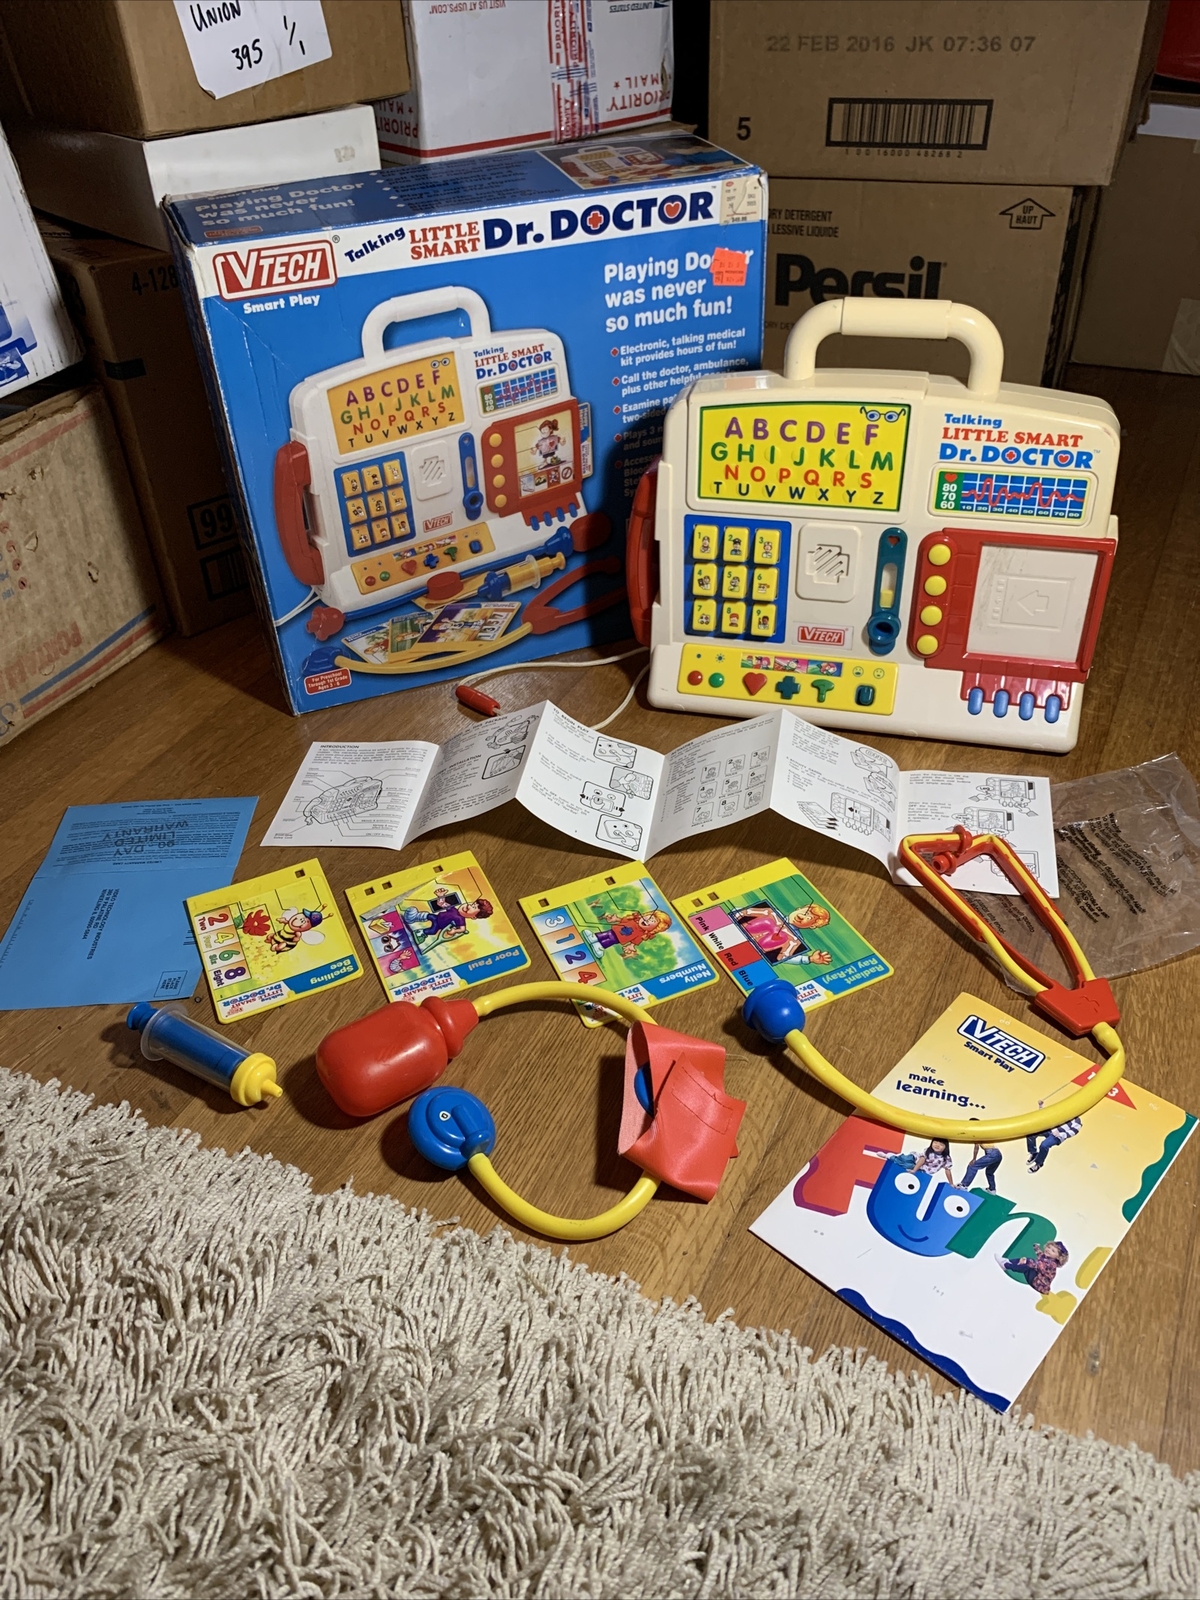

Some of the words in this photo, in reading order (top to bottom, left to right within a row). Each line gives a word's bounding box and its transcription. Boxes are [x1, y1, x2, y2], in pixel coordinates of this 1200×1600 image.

[190, 0, 241, 31] UNION
[609, 4, 629, 14] STATES
[631, 2, 653, 12] UNITED
[767, 35, 790, 52] 22
[797, 35, 840, 52] FEB
[847, 35, 895, 53] 2016
[905, 35, 934, 53] JK
[943, 35, 1002, 53] 07:36
[1010, 36, 1036, 53] 07
[231, 38, 263, 70] 395
[624, 72, 660, 90] MAIL
[736, 117, 751, 141] 5
[195, 194, 283, 211] Playing
[288, 182, 364, 198] Doctor
[198, 206, 247, 219] was
[254, 197, 319, 212] never
[202, 218, 230, 226] so
[238, 208, 303, 222] much
[309, 198, 355, 211] fun!
[785, 209, 833, 222] DETERGENT
[1022, 205, 1034, 215] UP
[483, 217, 544, 250] Dr.
[550, 190, 714, 241] DOCTOR
[1015, 215, 1038, 225] HAUT
[408, 221, 480, 245] LITTLE
[772, 224, 804, 236] LESSIVE
[807, 225, 839, 238] LIQUIDE
[344, 226, 406, 263] Talking
[410, 237, 481, 261] SMART
[225, 243, 325, 290] VTECH
[604, 257, 679, 285] Playing
[685, 247, 754, 271] Dor
[775, 252, 942, 306] Persil
[605, 288, 645, 308] was
[652, 277, 706, 298] never
[243, 296, 286, 314] Smart
[289, 294, 320, 311] Play
[606, 315, 629, 333] so
[634, 303, 687, 327] much
[693, 296, 732, 318] fun!
[620, 340, 670, 356] Electronic,
[672, 333, 704, 347] talking
[707, 328, 745, 341] medical
[473, 346, 504, 358] Talking
[474, 353, 509, 368] LITTLE
[511, 344, 545, 359] SMART
[620, 357, 633, 367] kit
[635, 348, 675, 365] provides
[676, 344, 703, 356] hours
[705, 341, 716, 352] of
[717, 340, 737, 351] fun!
[476, 366, 497, 380] Dr.
[499, 351, 552, 374] DOCTOR
[621, 374, 640, 385] Call
[642, 369, 658, 380] the
[659, 363, 691, 377] doctor,
[693, 357, 749, 371] ambulance,
[621, 385, 641, 398] plus
[643, 378, 668, 391] other
[622, 399, 660, 413] Examine
[944, 413, 1003, 429] Talking
[623, 427, 647, 440] Plays
[724, 416, 743, 439] A
[752, 418, 769, 441] B
[779, 419, 798, 442] C
[806, 420, 826, 443] D
[836, 422, 851, 445] E
[864, 424, 879, 446] F
[941, 427, 1009, 443] LITTLE
[1013, 431, 1084, 448] SMART
[624, 440, 640, 451] and
[710, 442, 728, 462] G
[737, 443, 755, 463] H
[793, 447, 805, 466] J
[819, 448, 836, 468] K
[849, 449, 861, 469] L
[870, 451, 894, 472] M
[939, 443, 977, 462] Dr.
[981, 445, 1094, 469] DOCTOR
[724, 464, 740, 481] N
[750, 466, 766, 482] O
[778, 467, 792, 484] P
[803, 469, 820, 487] Q
[832, 470, 846, 488] R
[859, 472, 873, 489] S
[713, 481, 723, 494] T
[738, 483, 750, 497] U
[764, 484, 776, 498] V
[788, 485, 805, 500] W
[817, 488, 830, 502] X
[846, 490, 857, 503] Y
[872, 491, 884, 505] Z
[941, 491, 956, 501] 70
[942, 483, 957, 493] 80
[940, 500, 955, 510] 60
[200, 503, 233, 538] 99
[803, 626, 843, 643] VTECH
[102, 819, 189, 842] WARRANTY
[114, 831, 176, 847] LIMITED
[113, 844, 145, 857] DAY
[197, 916, 207, 931] Two
[207, 913, 229, 926] 2
[544, 915, 565, 927] 3
[695, 916, 710, 931] Pink
[213, 931, 234, 945] 4
[556, 933, 576, 945] 1
[708, 932, 725, 950] White
[218, 949, 241, 962] 6
[330, 958, 352, 970] Bee
[494, 948, 520, 962] Poor
[564, 950, 587, 965] 2
[723, 952, 739, 967] Red
[857, 958, 879, 970] Ray
[224, 966, 247, 981] 8
[468, 958, 493, 972] Paul
[659, 963, 707, 985] Numbers
[213, 969, 225, 987] Eight
[310, 965, 354, 985] Spelling
[577, 970, 598, 984] 4
[685, 969, 712, 984] Nelly
[738, 970, 754, 987] Blue
[821, 965, 858, 985] (X-Ray)
[846, 965, 886, 985] Radiant
[394, 977, 435, 996] DOCTOR
[222, 988, 265, 1007] DOCTOR
[967, 1016, 1040, 1070] VTECH
[963, 1040, 994, 1063] Smart
[993, 1055, 1016, 1074] Play
[908, 1071, 945, 1087] make
[921, 1065, 937, 1075] We
[895, 1079, 986, 1110] learning...
